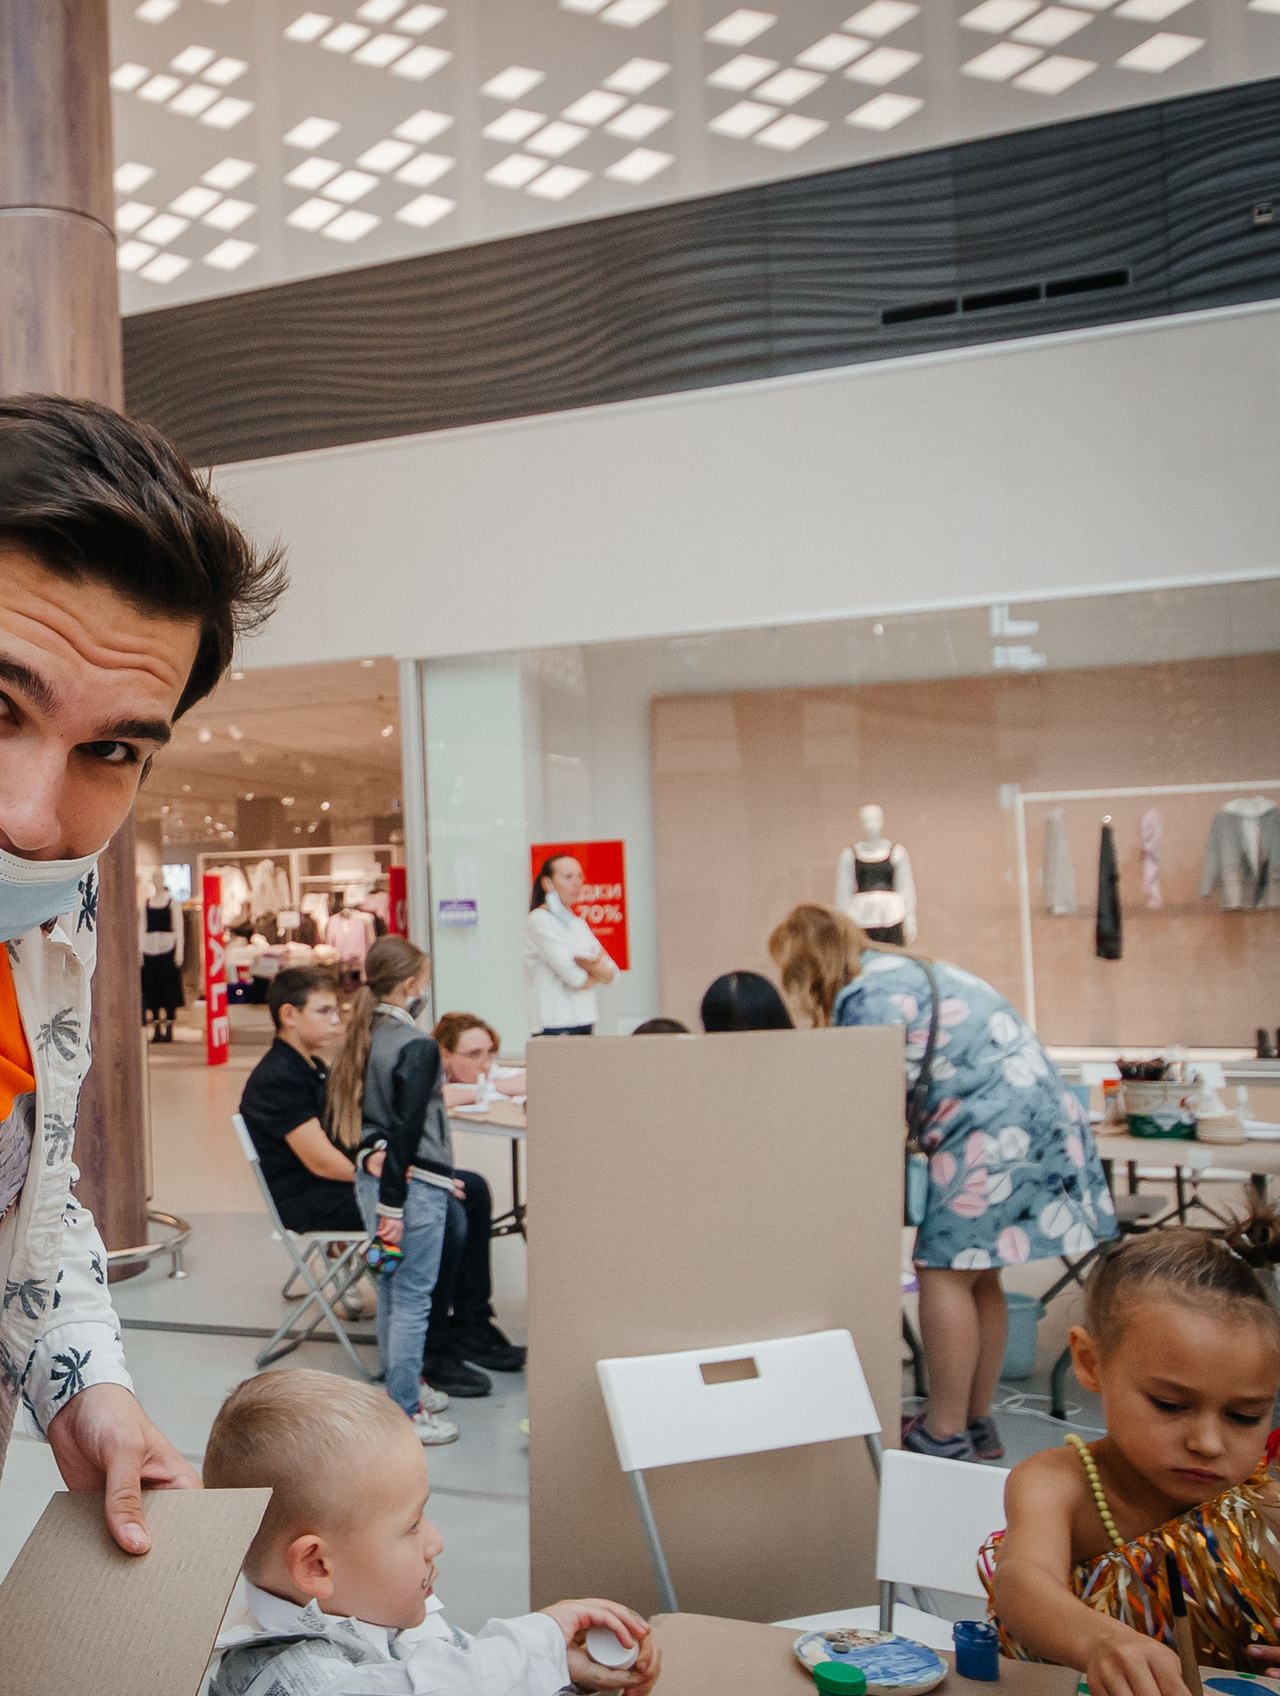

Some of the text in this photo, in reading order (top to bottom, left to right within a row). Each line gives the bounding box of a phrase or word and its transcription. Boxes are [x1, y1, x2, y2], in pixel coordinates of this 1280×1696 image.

[578, 884, 621, 901] ДКИ
[578, 904, 623, 924] 70%
[207, 904, 228, 1047] SALE
